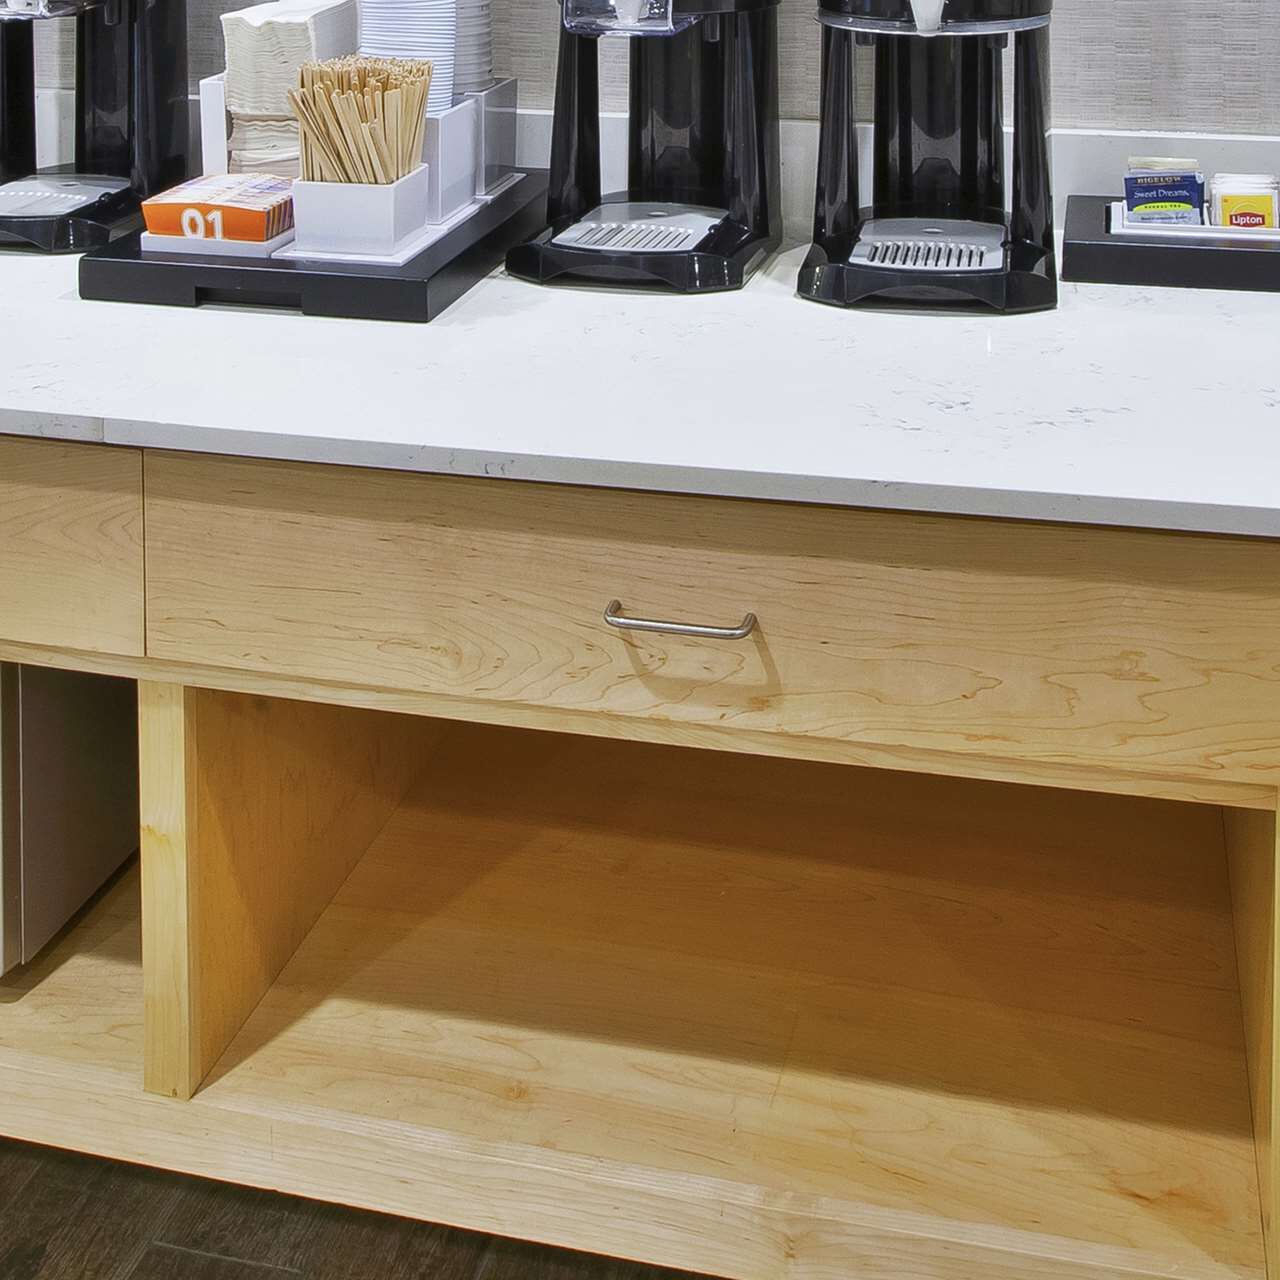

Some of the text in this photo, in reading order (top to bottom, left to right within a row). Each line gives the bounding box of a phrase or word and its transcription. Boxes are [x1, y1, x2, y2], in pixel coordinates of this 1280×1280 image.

[1134, 190, 1157, 199] Sweet
[180, 208, 225, 241] 01
[1231, 214, 1263, 226] Lipton
